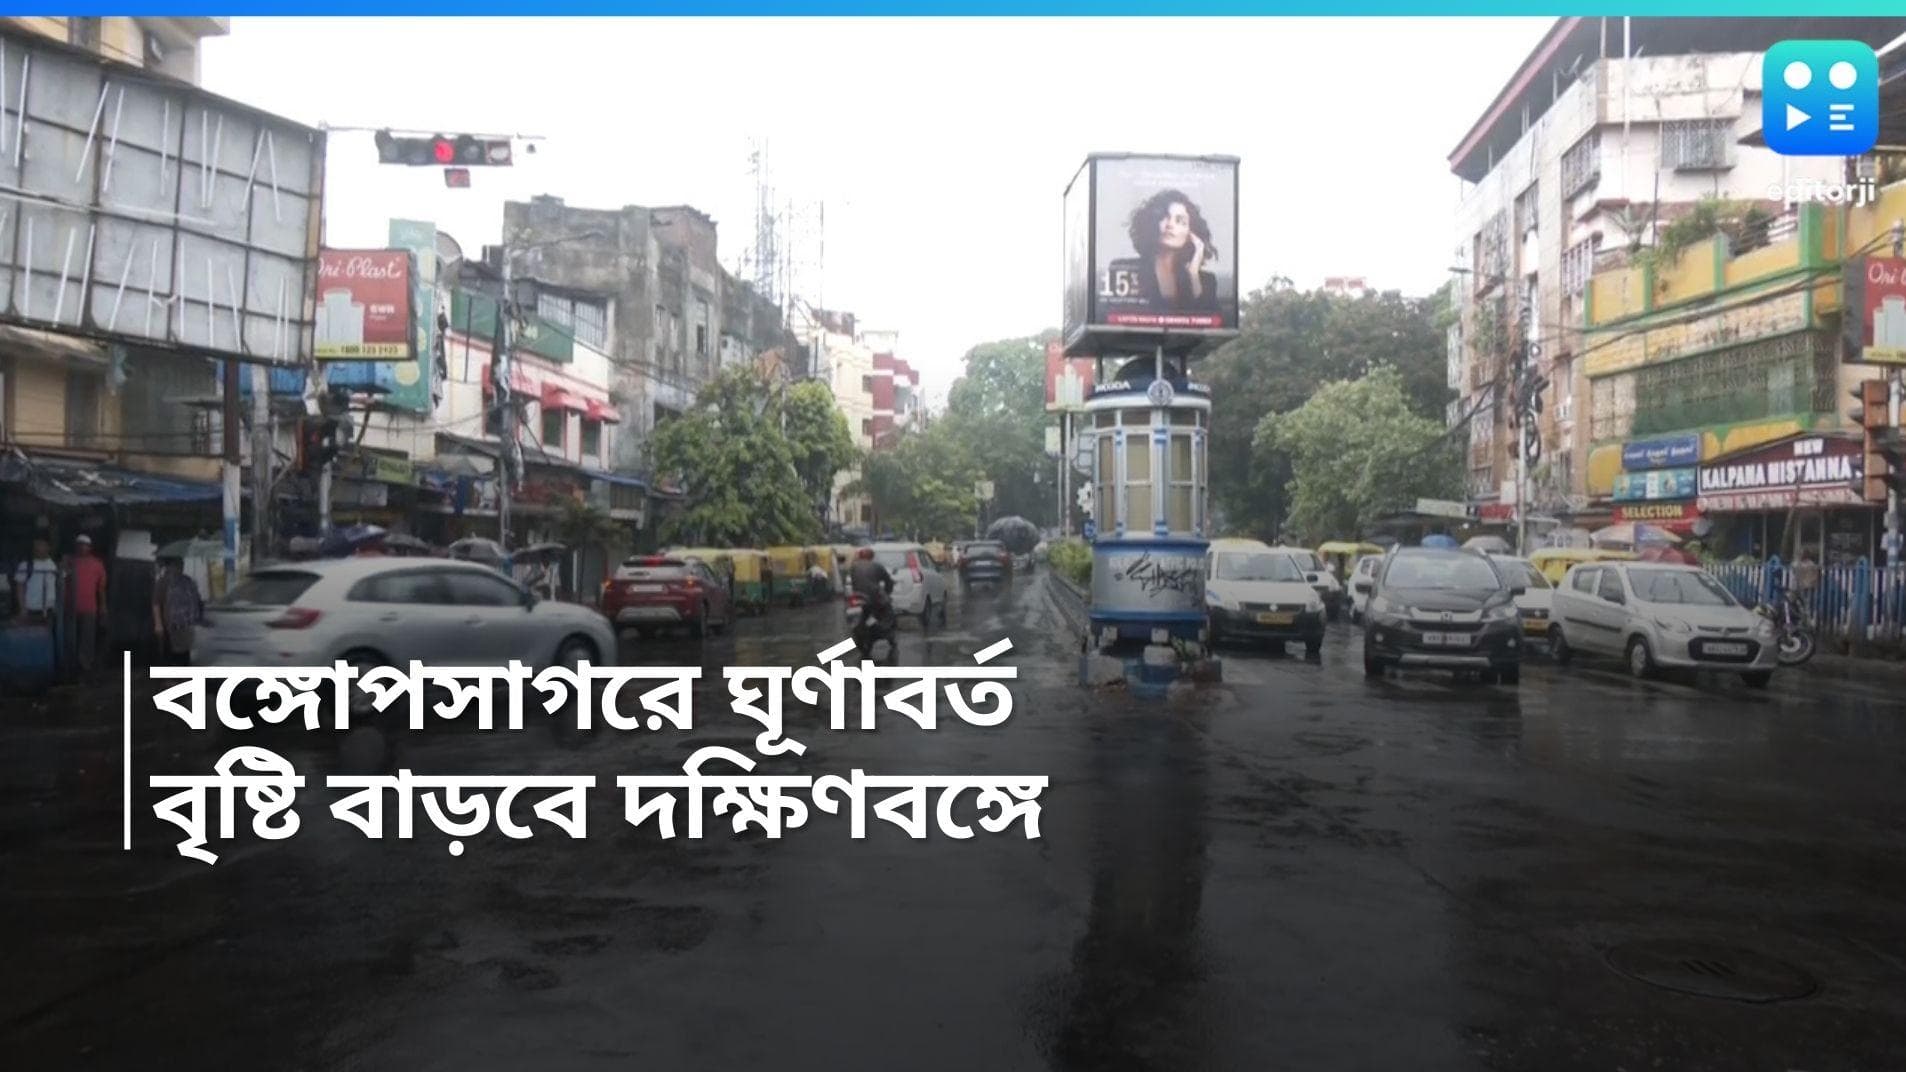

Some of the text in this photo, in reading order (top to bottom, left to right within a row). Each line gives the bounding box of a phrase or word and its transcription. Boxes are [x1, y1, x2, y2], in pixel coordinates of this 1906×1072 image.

[1793, 438, 1824, 457] NEW
[1702, 463, 1766, 490] KALPANA
[1767, 455, 1852, 486] MISTANNA
[1621, 505, 1683, 519] SELECTION
